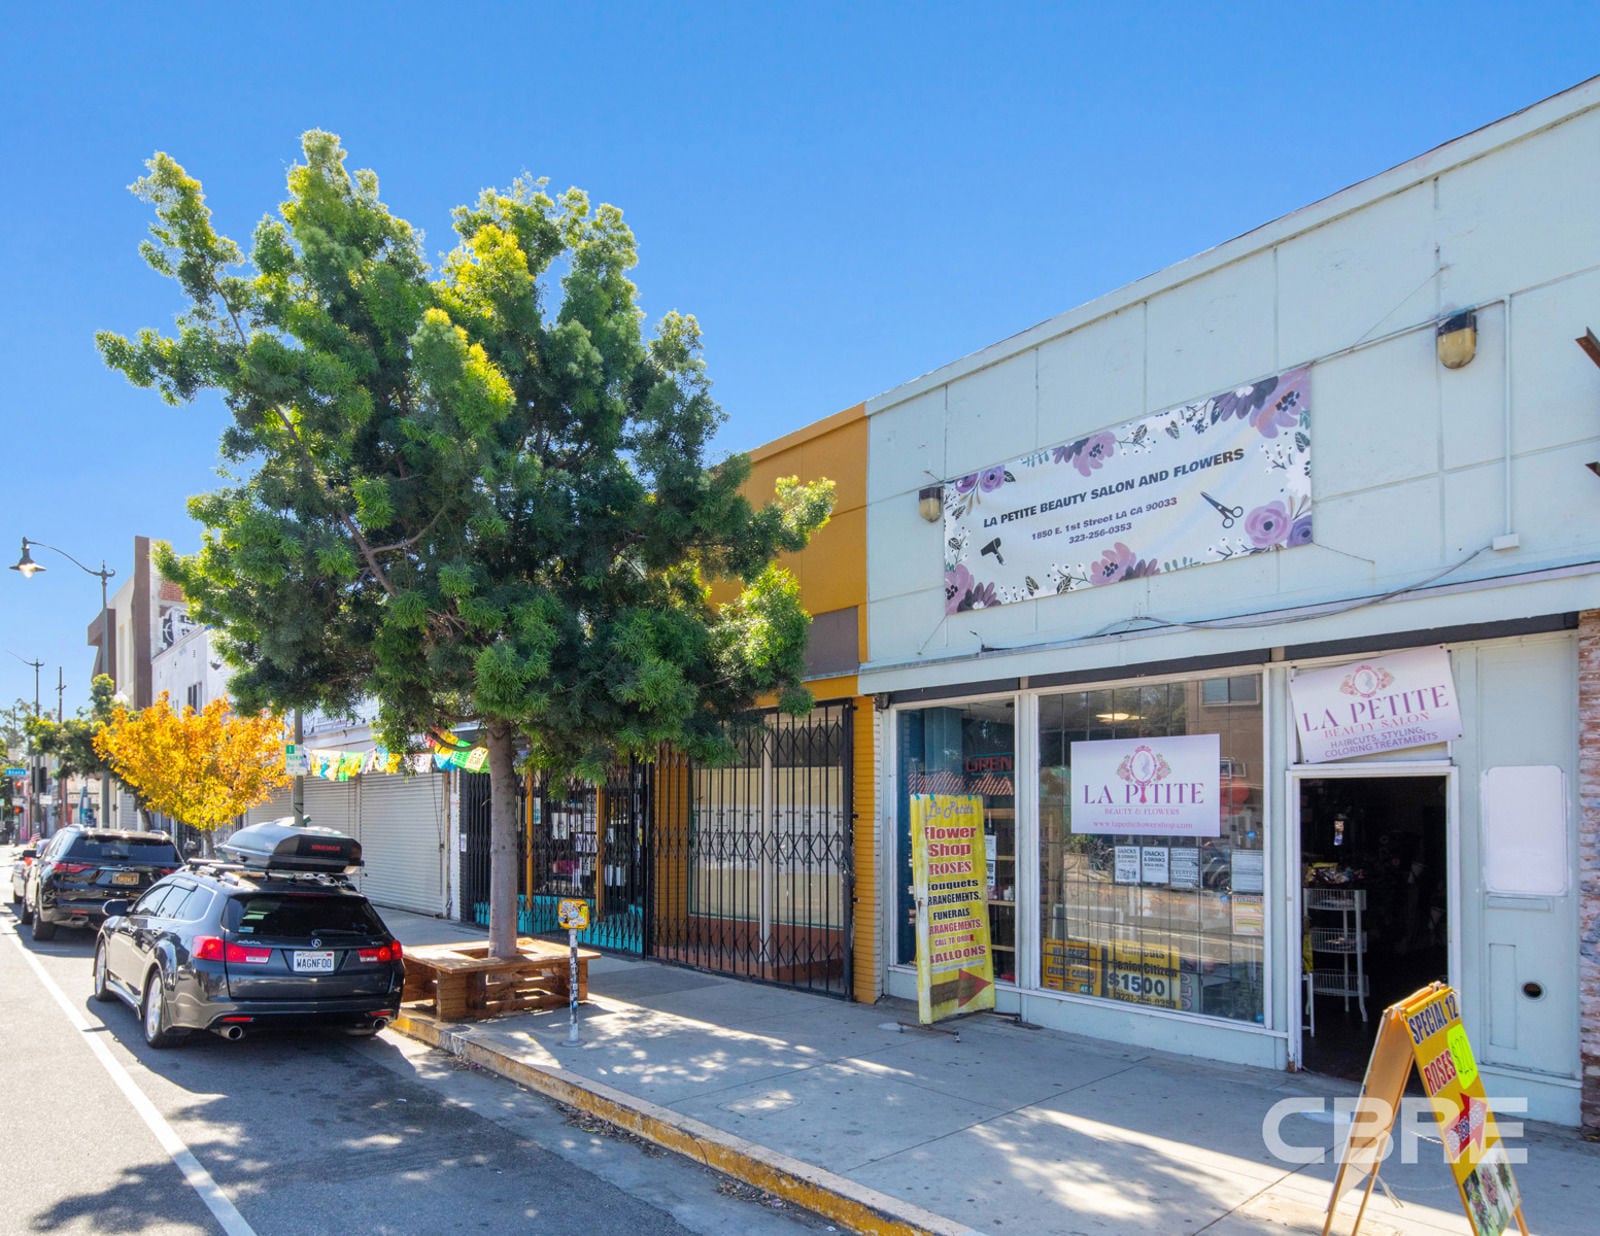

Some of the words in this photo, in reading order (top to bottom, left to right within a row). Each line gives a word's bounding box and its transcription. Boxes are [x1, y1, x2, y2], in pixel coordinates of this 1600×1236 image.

[983, 516, 998, 528] LA
[1000, 505, 1037, 524] PETITE
[1040, 492, 1087, 513] BEAUTY
[1090, 481, 1135, 500] SALON
[1138, 470, 1169, 488] AND
[1173, 448, 1245, 478] FLOWERS
[1031, 529, 1053, 540] 1850
[1055, 526, 1063, 535] E.
[1065, 522, 1081, 532] 1st
[1083, 514, 1113, 528] Street
[1115, 510, 1127, 520] LA
[1130, 506, 1143, 516] CA
[1145, 497, 1178, 512] 90033
[1068, 522, 1132, 544] 323-256-0353
[1303, 708, 1339, 732] LA
[1350, 685, 1449, 724] PETITE
[1324, 723, 1375, 739] BEAUTY
[1380, 712, 1430, 728] SALON
[1324, 744, 1373, 758] COLORING
[1375, 732, 1439, 749] TREATMENTS
[966, 755, 1013, 772] OPEN
[1084, 784, 1114, 804] LA
[924, 826, 976, 840] Flower
[928, 843, 972, 857] Shop
[928, 861, 973, 876] ROSES
[932, 908, 970, 920] FUNERALS
[1408, 1000, 1449, 1045] SPECIAL
[1444, 993, 1460, 1020] 12
[1423, 1049, 1457, 1096] ROSES
